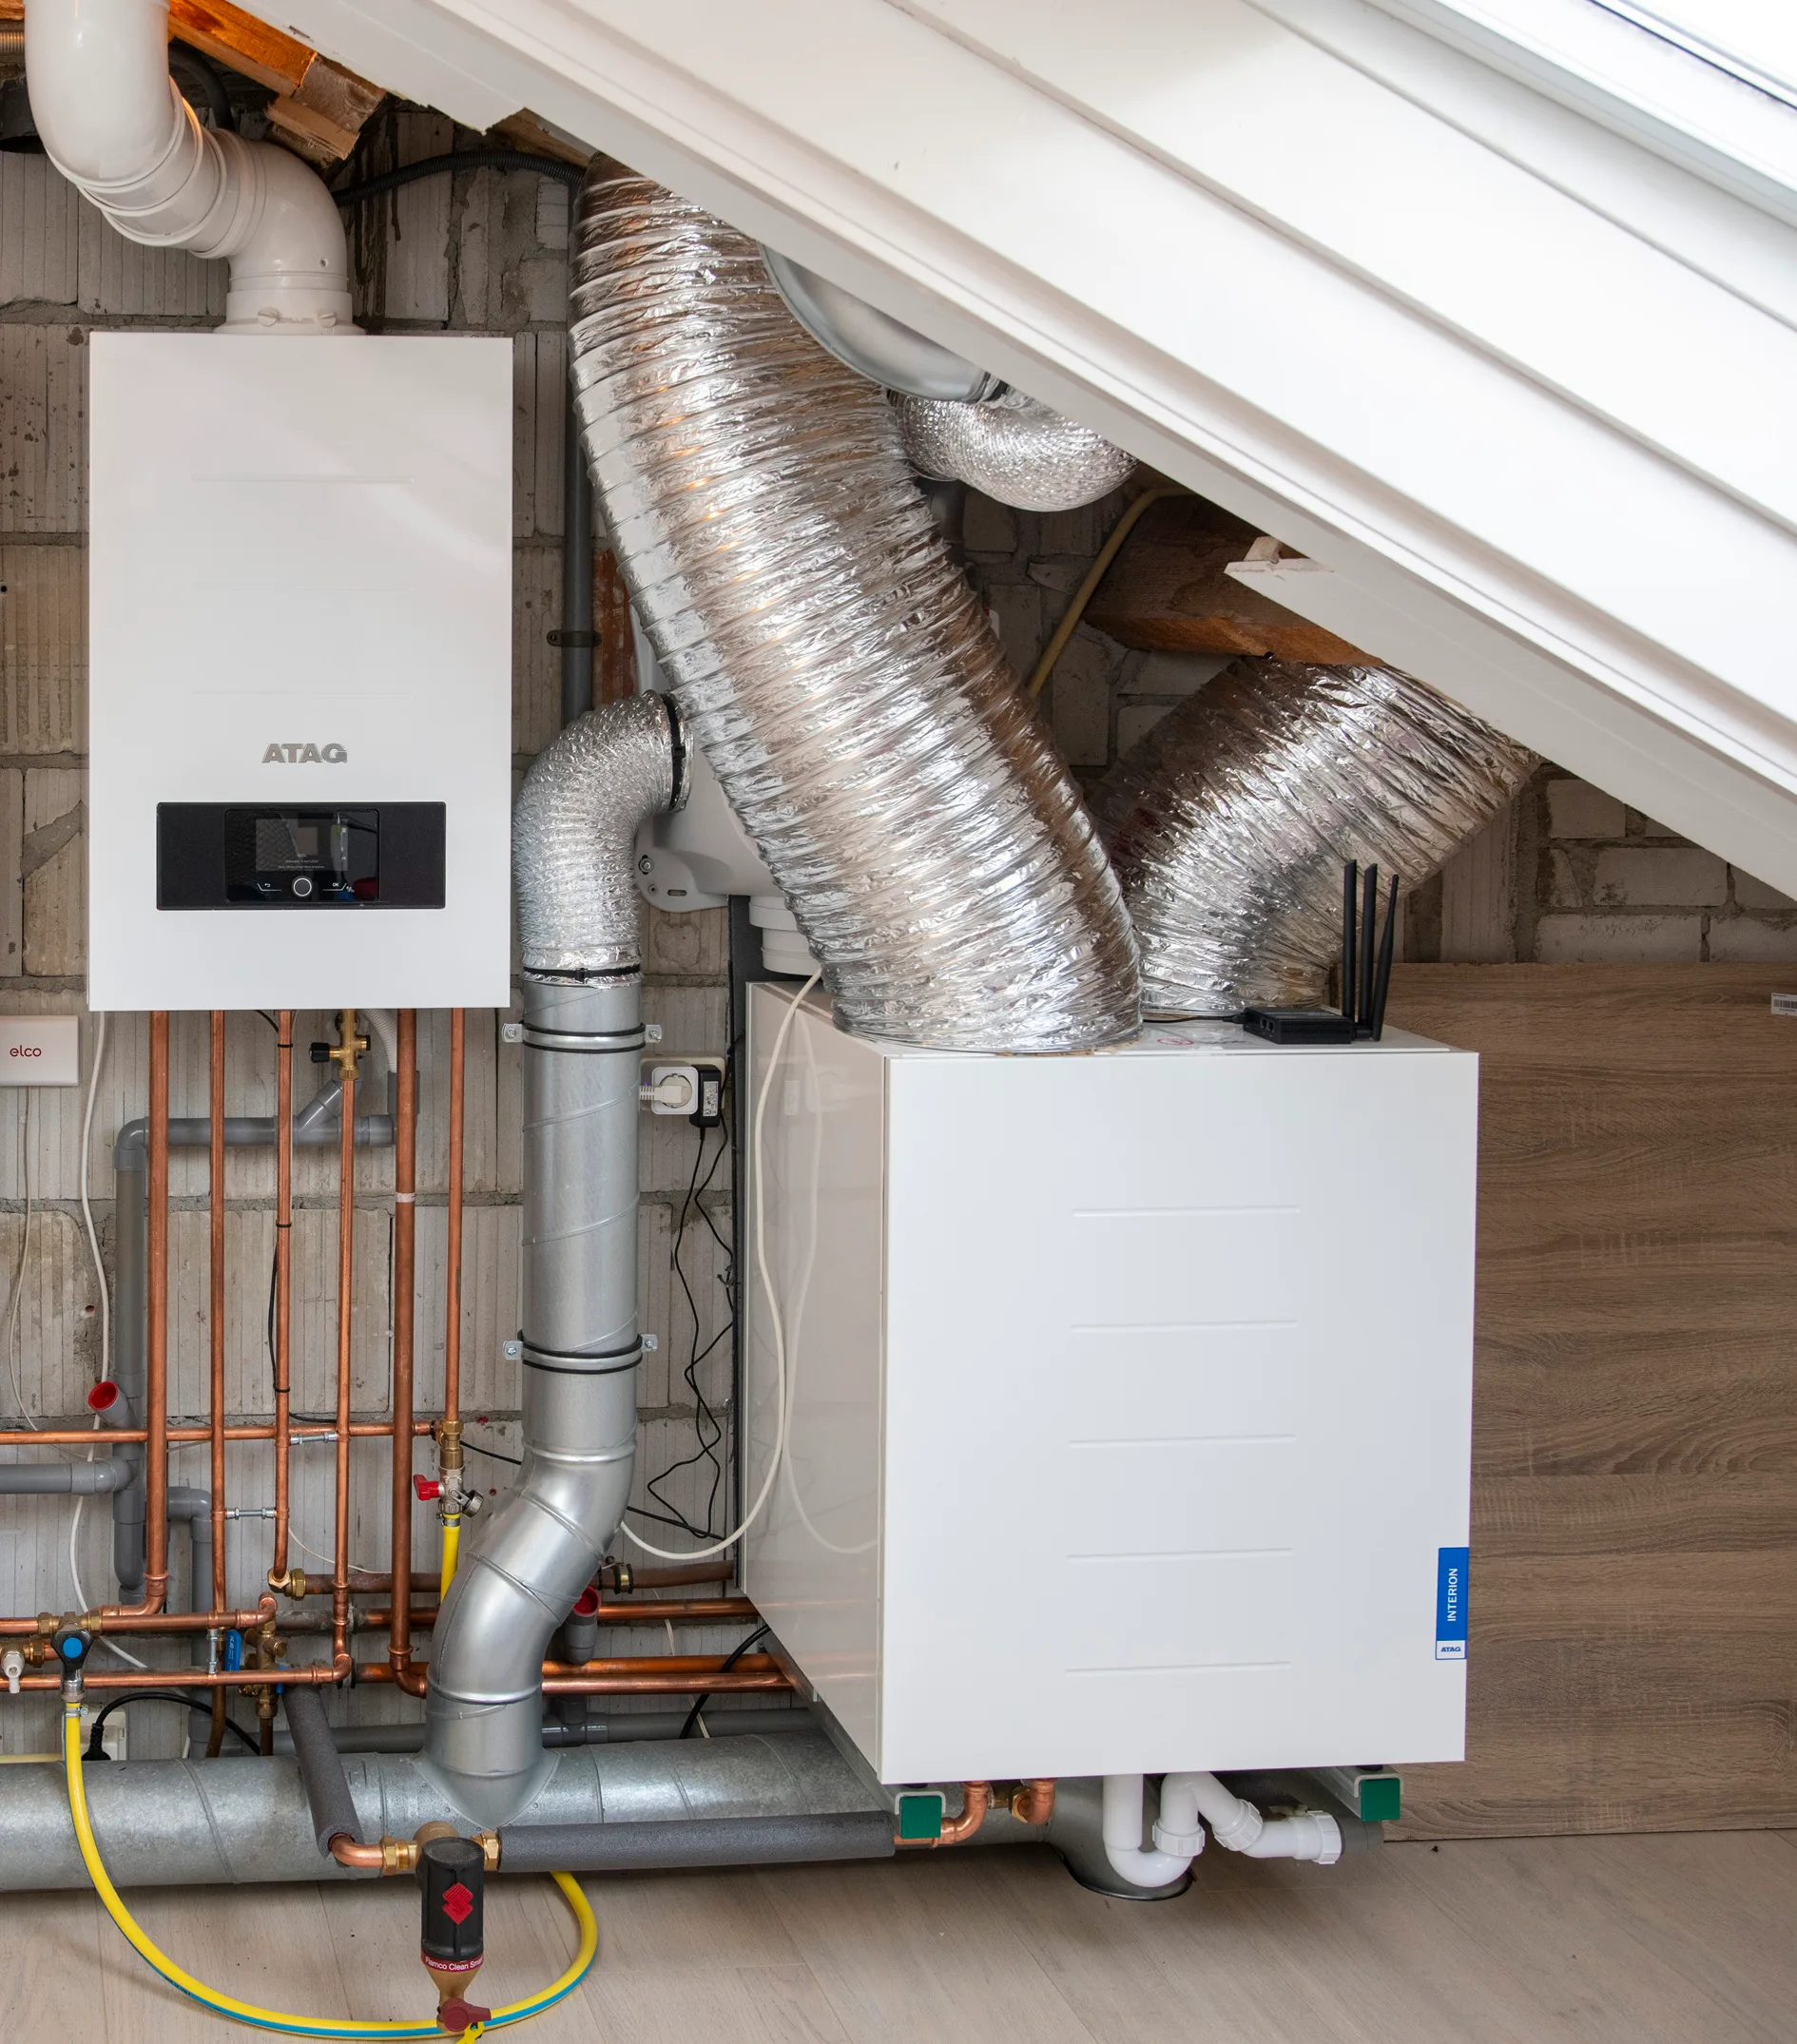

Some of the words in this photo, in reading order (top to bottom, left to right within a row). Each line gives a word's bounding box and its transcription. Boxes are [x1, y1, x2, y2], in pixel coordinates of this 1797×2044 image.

[261, 742, 348, 763] ATAG
[10, 1045, 42, 1057] elco
[1447, 1568, 1459, 1622] INTERION
[425, 1957, 448, 1970] Flamco
